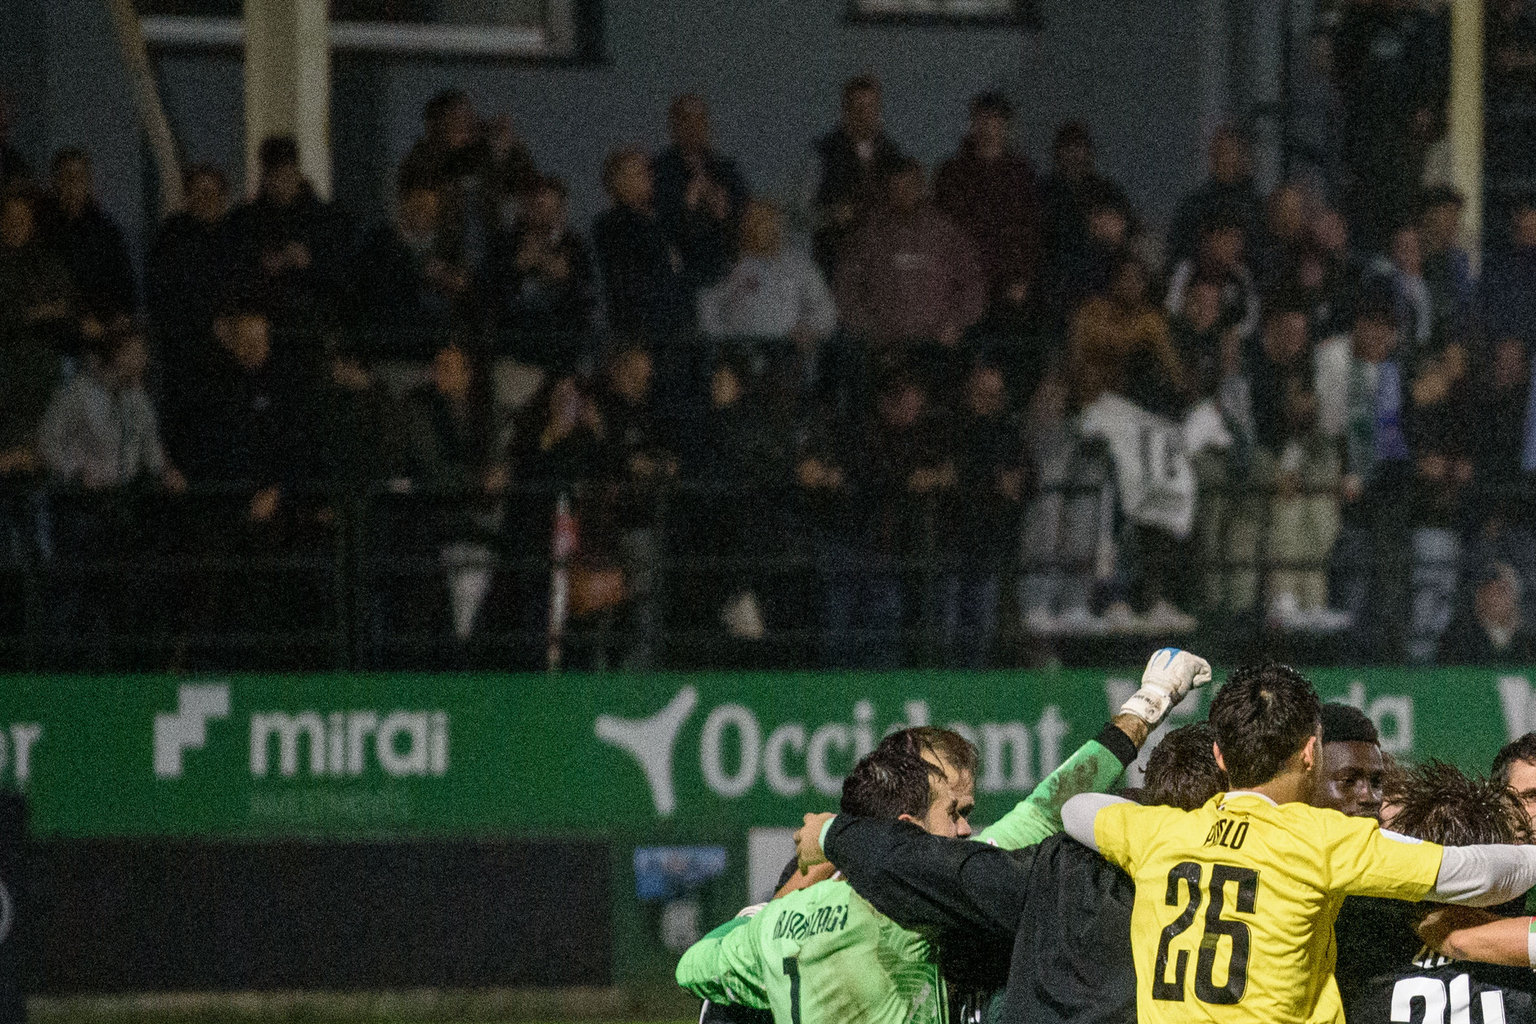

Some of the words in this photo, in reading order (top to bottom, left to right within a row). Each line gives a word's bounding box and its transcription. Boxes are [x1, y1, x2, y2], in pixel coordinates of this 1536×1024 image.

[249, 711, 450, 778] mirai
[699, 699, 1068, 799] Occint
[1152, 860, 1260, 1005] 26
